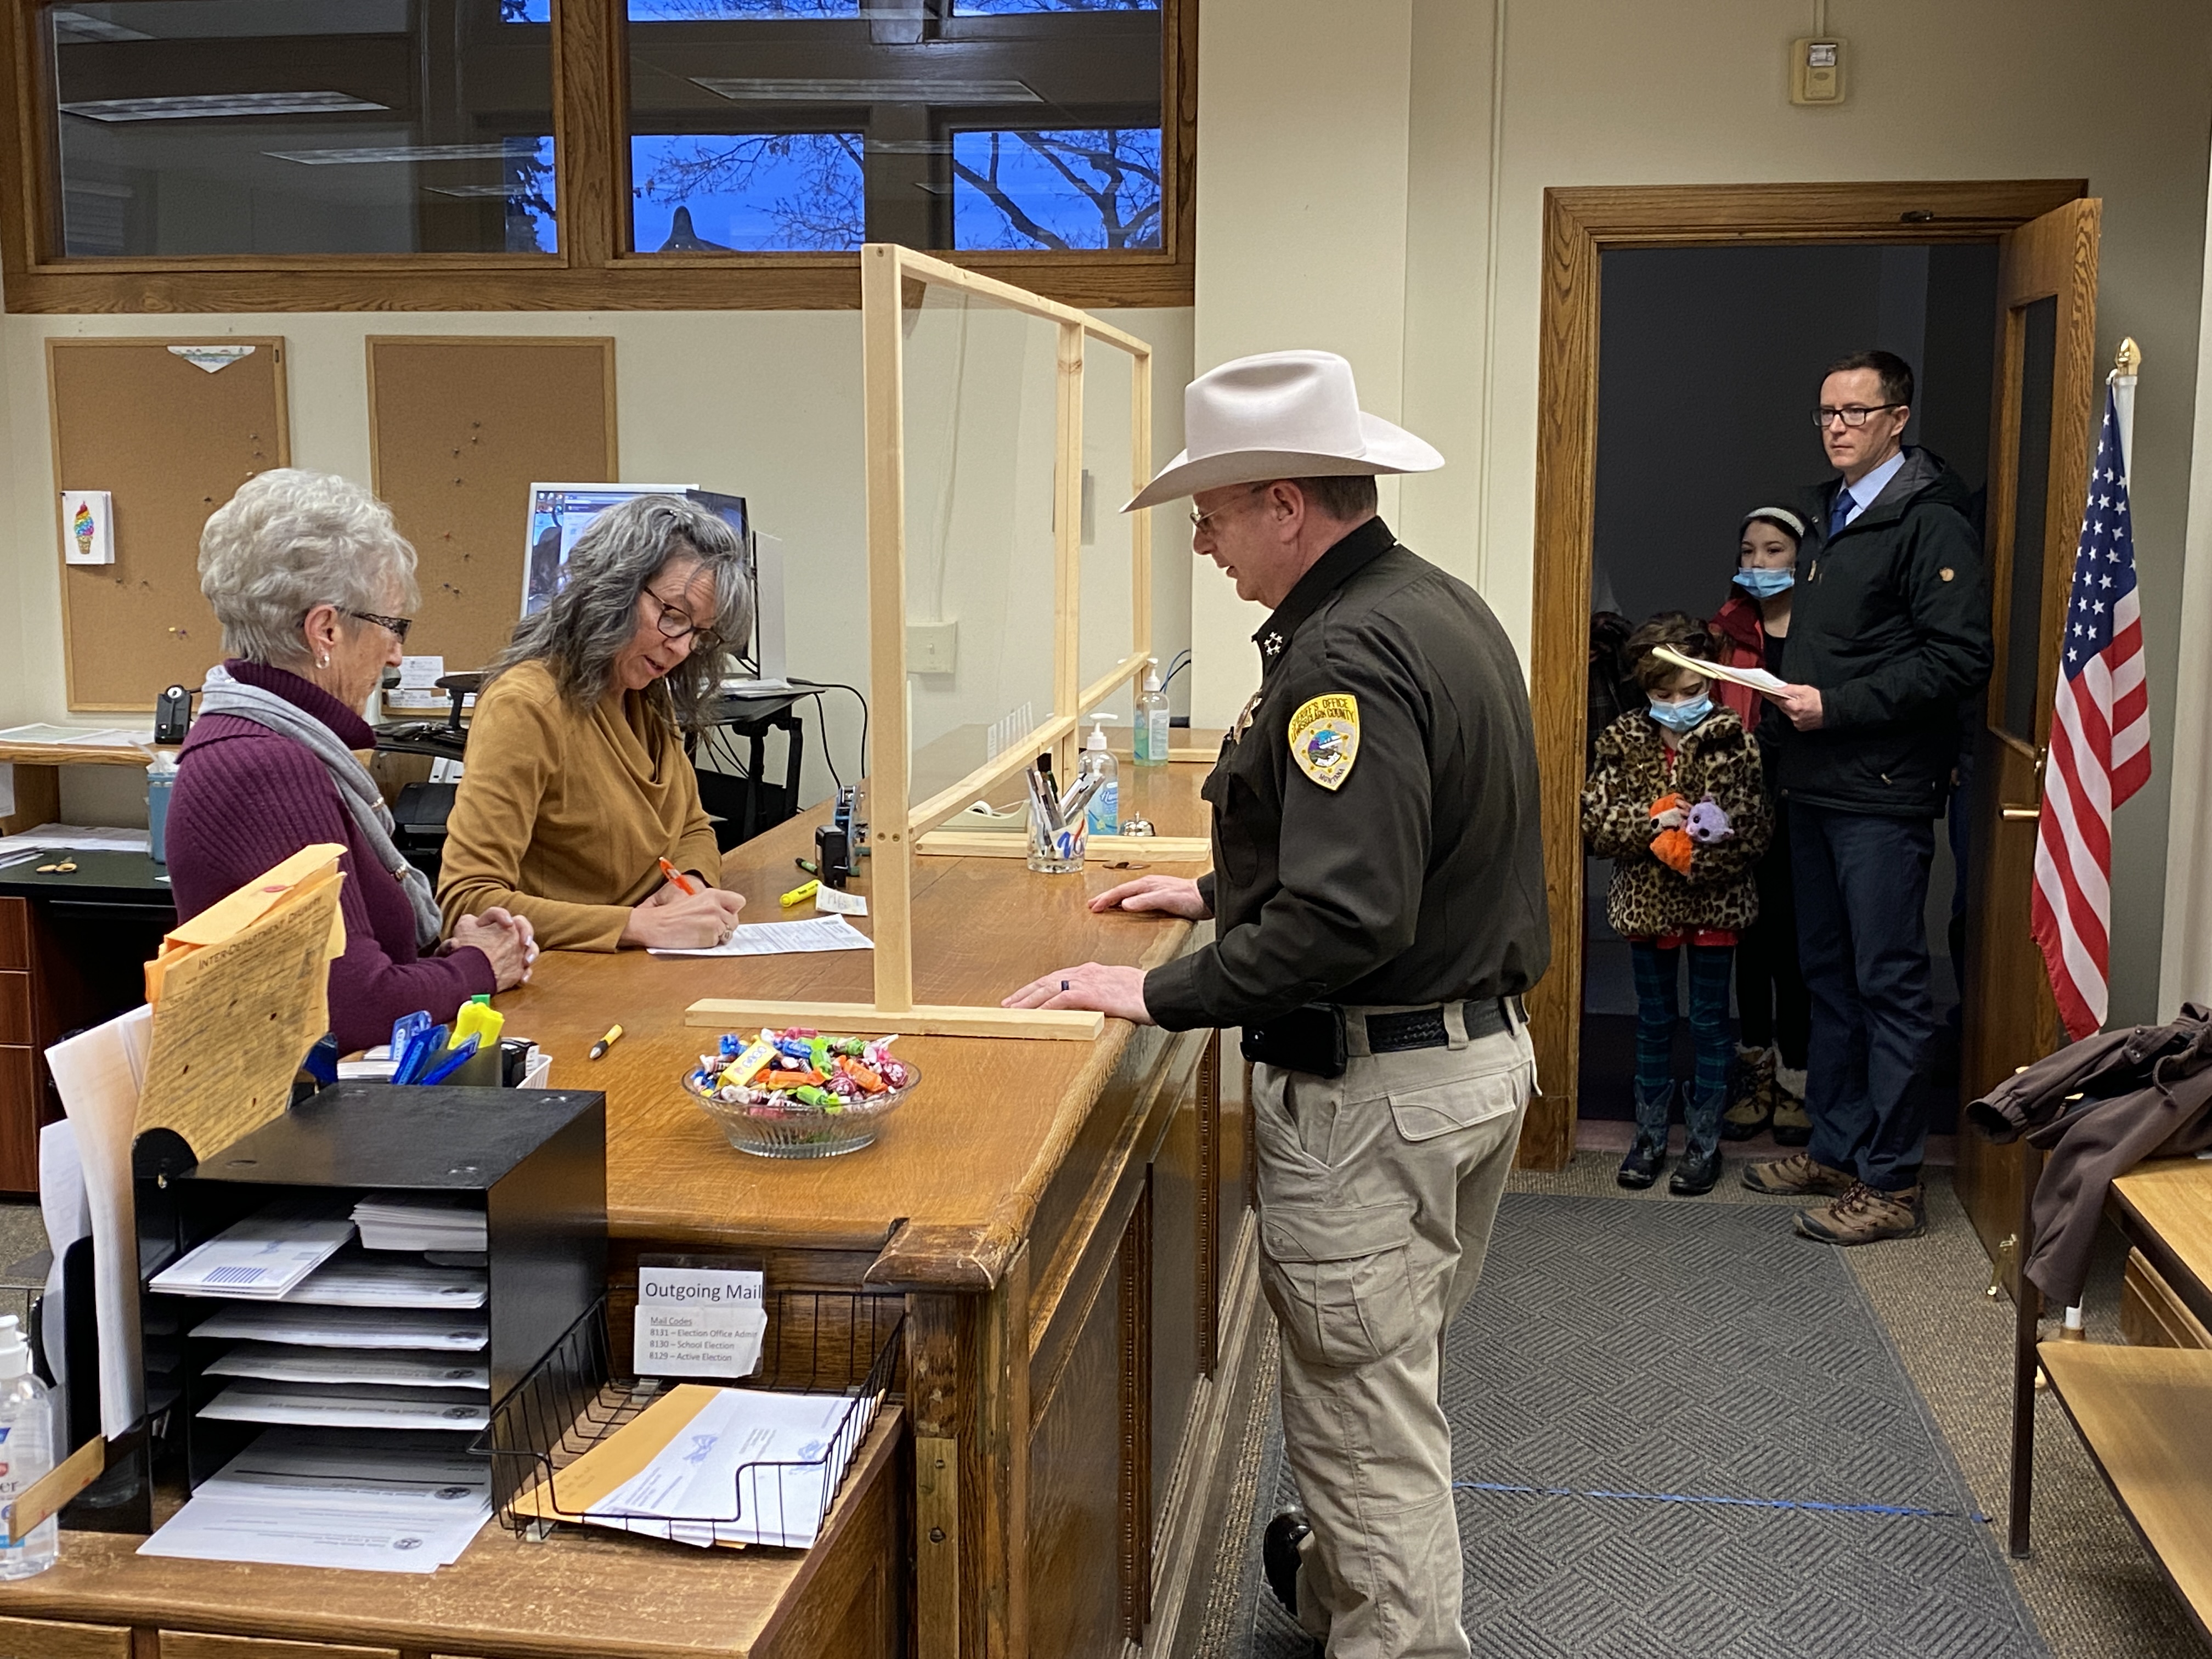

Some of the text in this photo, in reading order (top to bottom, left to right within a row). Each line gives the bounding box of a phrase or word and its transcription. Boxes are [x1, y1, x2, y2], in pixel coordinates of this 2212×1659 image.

[1322, 698, 1348, 708] OFFICE
[1327, 708, 1355, 723] COUNTY
[1318, 769, 1346, 784] MONTANA
[645, 1282, 762, 1302] Outgoing Mail
[651, 1317, 692, 1325] Mail Codes
